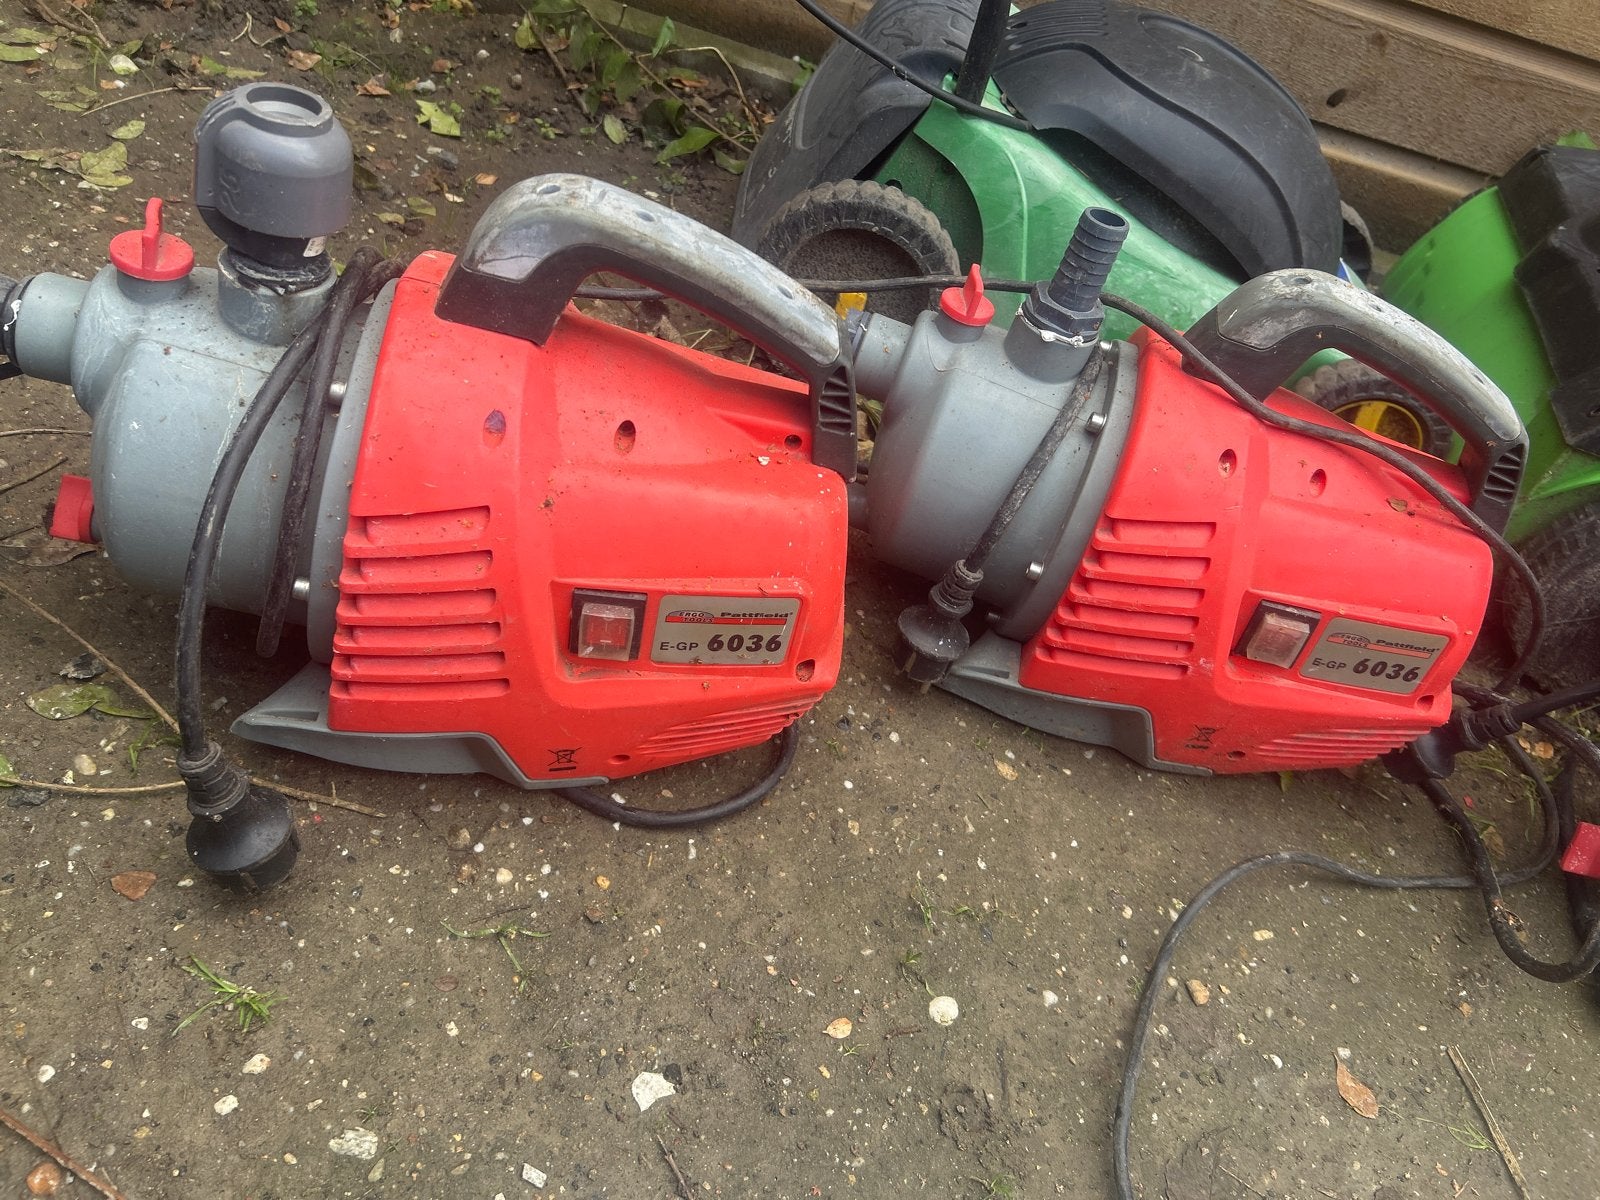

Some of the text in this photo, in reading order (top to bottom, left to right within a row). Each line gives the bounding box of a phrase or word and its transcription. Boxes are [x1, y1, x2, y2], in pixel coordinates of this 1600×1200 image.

[659, 634, 782, 652] E-GP 6036
[1311, 657, 1421, 682] E-GP 6036
